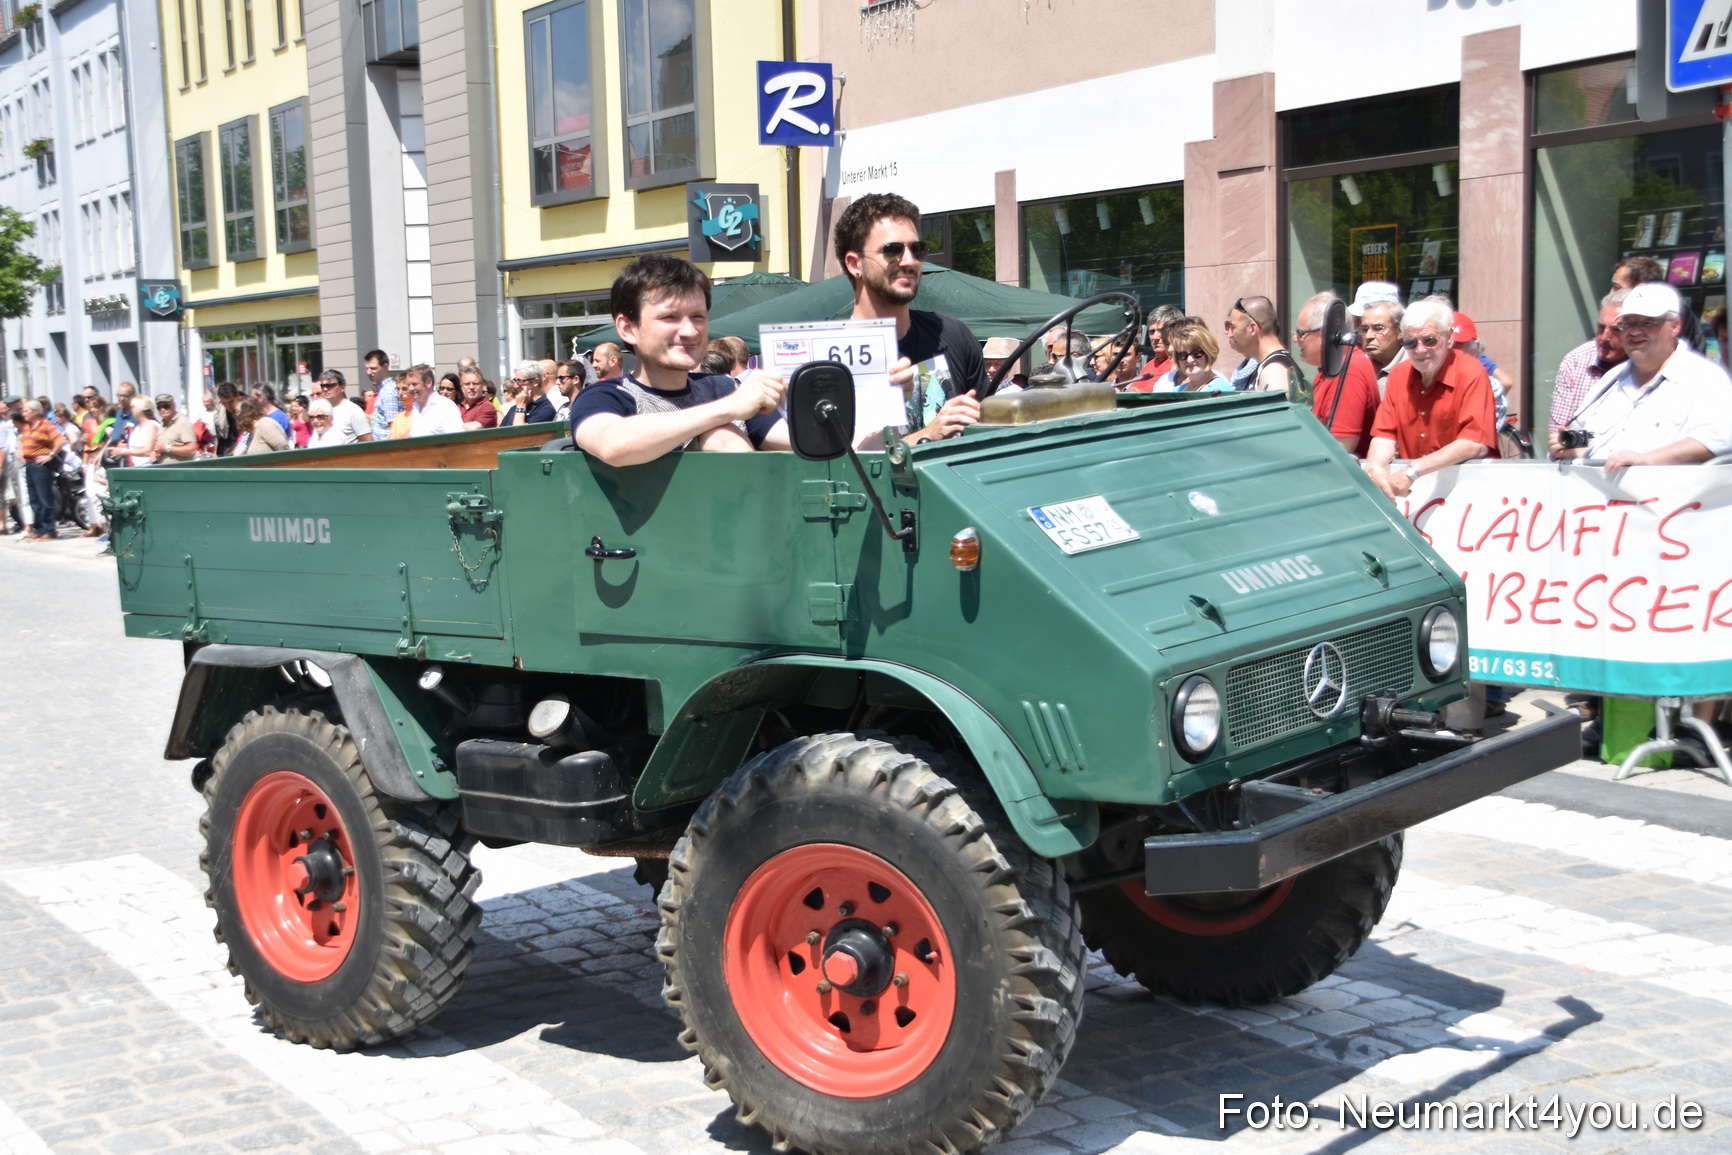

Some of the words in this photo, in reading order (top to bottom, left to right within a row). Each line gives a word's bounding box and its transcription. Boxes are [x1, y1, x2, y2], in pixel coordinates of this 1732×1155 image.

[764, 72, 830, 135] R.
[842, 169, 866, 185] Unterer
[867, 164, 888, 181] Markt
[889, 162, 898, 176] 15
[718, 204, 743, 236] G2
[1362, 242, 1388, 255] WEBER'S
[828, 344, 872, 366] 615
[1046, 505, 1081, 526] NM
[249, 517, 332, 543] UNIMOG
[1220, 554, 1324, 594] UNIMOG
